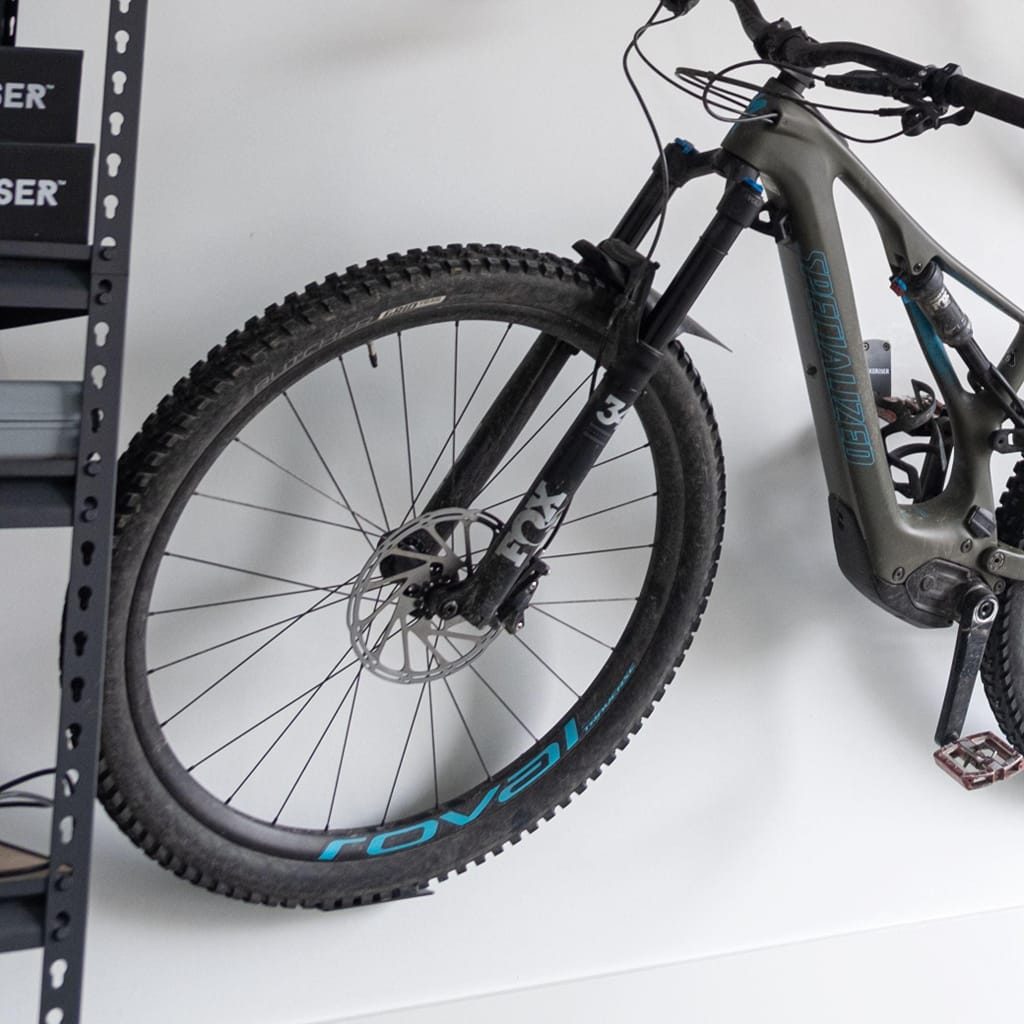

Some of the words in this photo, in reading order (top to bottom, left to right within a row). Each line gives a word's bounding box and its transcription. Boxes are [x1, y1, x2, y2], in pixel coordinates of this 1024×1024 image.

[801, 250, 877, 467] SPECIALIZED
[495, 479, 568, 568] FOX
[317, 717, 579, 861] roval
